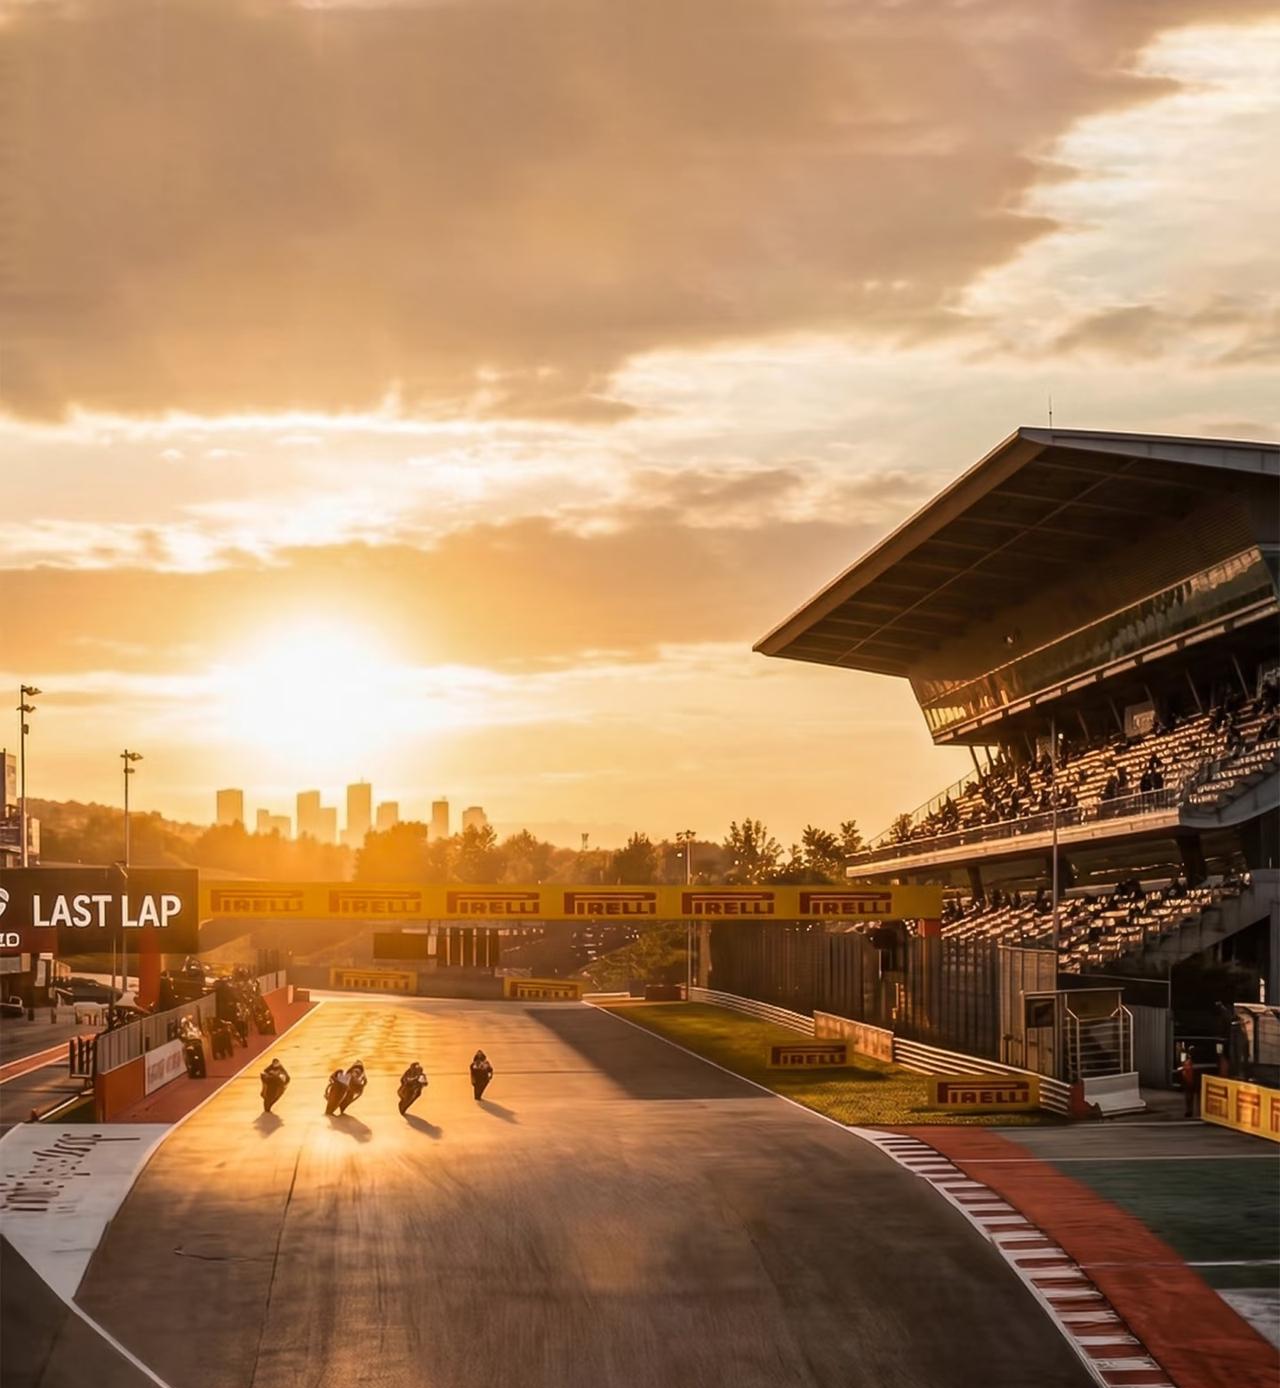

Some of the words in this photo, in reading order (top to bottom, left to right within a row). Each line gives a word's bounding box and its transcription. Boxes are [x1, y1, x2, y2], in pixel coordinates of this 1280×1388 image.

[33, 894, 112, 927] LAST
[121, 894, 182, 927] LAP
[329, 890, 421, 914] PIRELLI
[447, 891, 540, 915] PIRELLI
[564, 891, 656, 915] PIRELLI
[682, 891, 774, 915] PIRELLI
[800, 891, 892, 915] PIRELLI
[771, 1044, 847, 1066] PIRELLI
[936, 1081, 1030, 1104] PIRELLI
